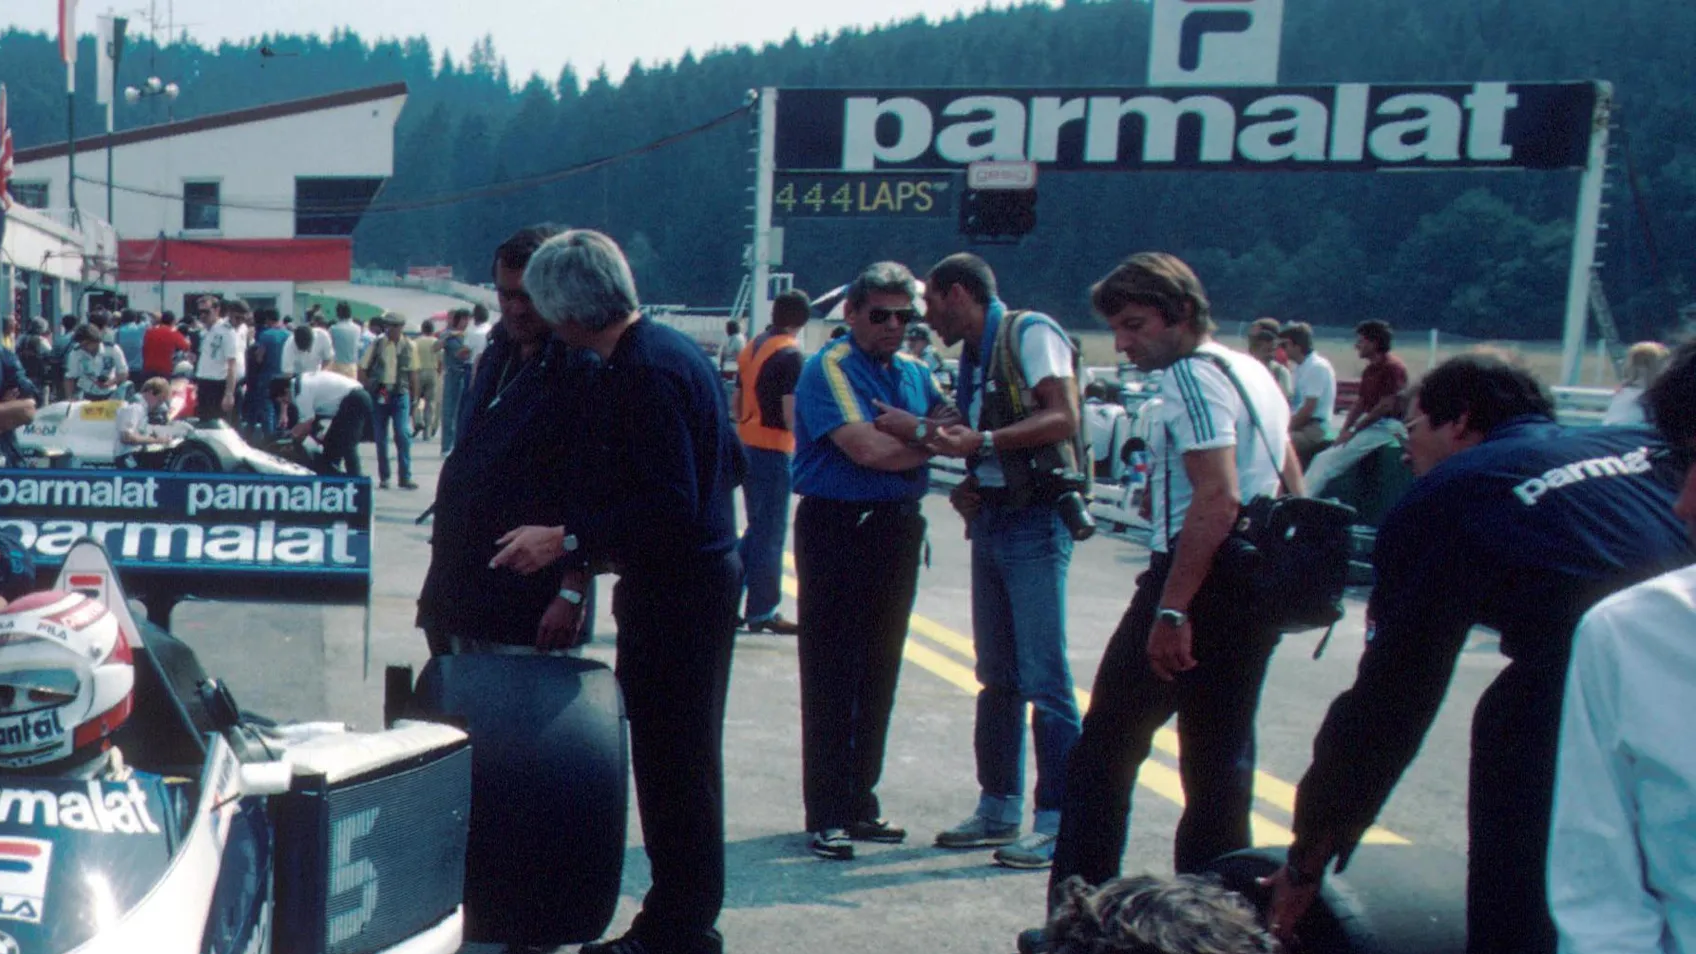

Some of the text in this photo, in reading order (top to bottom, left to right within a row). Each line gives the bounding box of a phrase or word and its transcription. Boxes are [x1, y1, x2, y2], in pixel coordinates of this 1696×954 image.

[841, 81, 1518, 171] parmalat
[859, 181, 933, 212] LAPS
[187, 478, 358, 515] parmalat
[37, 622, 69, 640] FILA
[329, 806, 382, 944] 5
